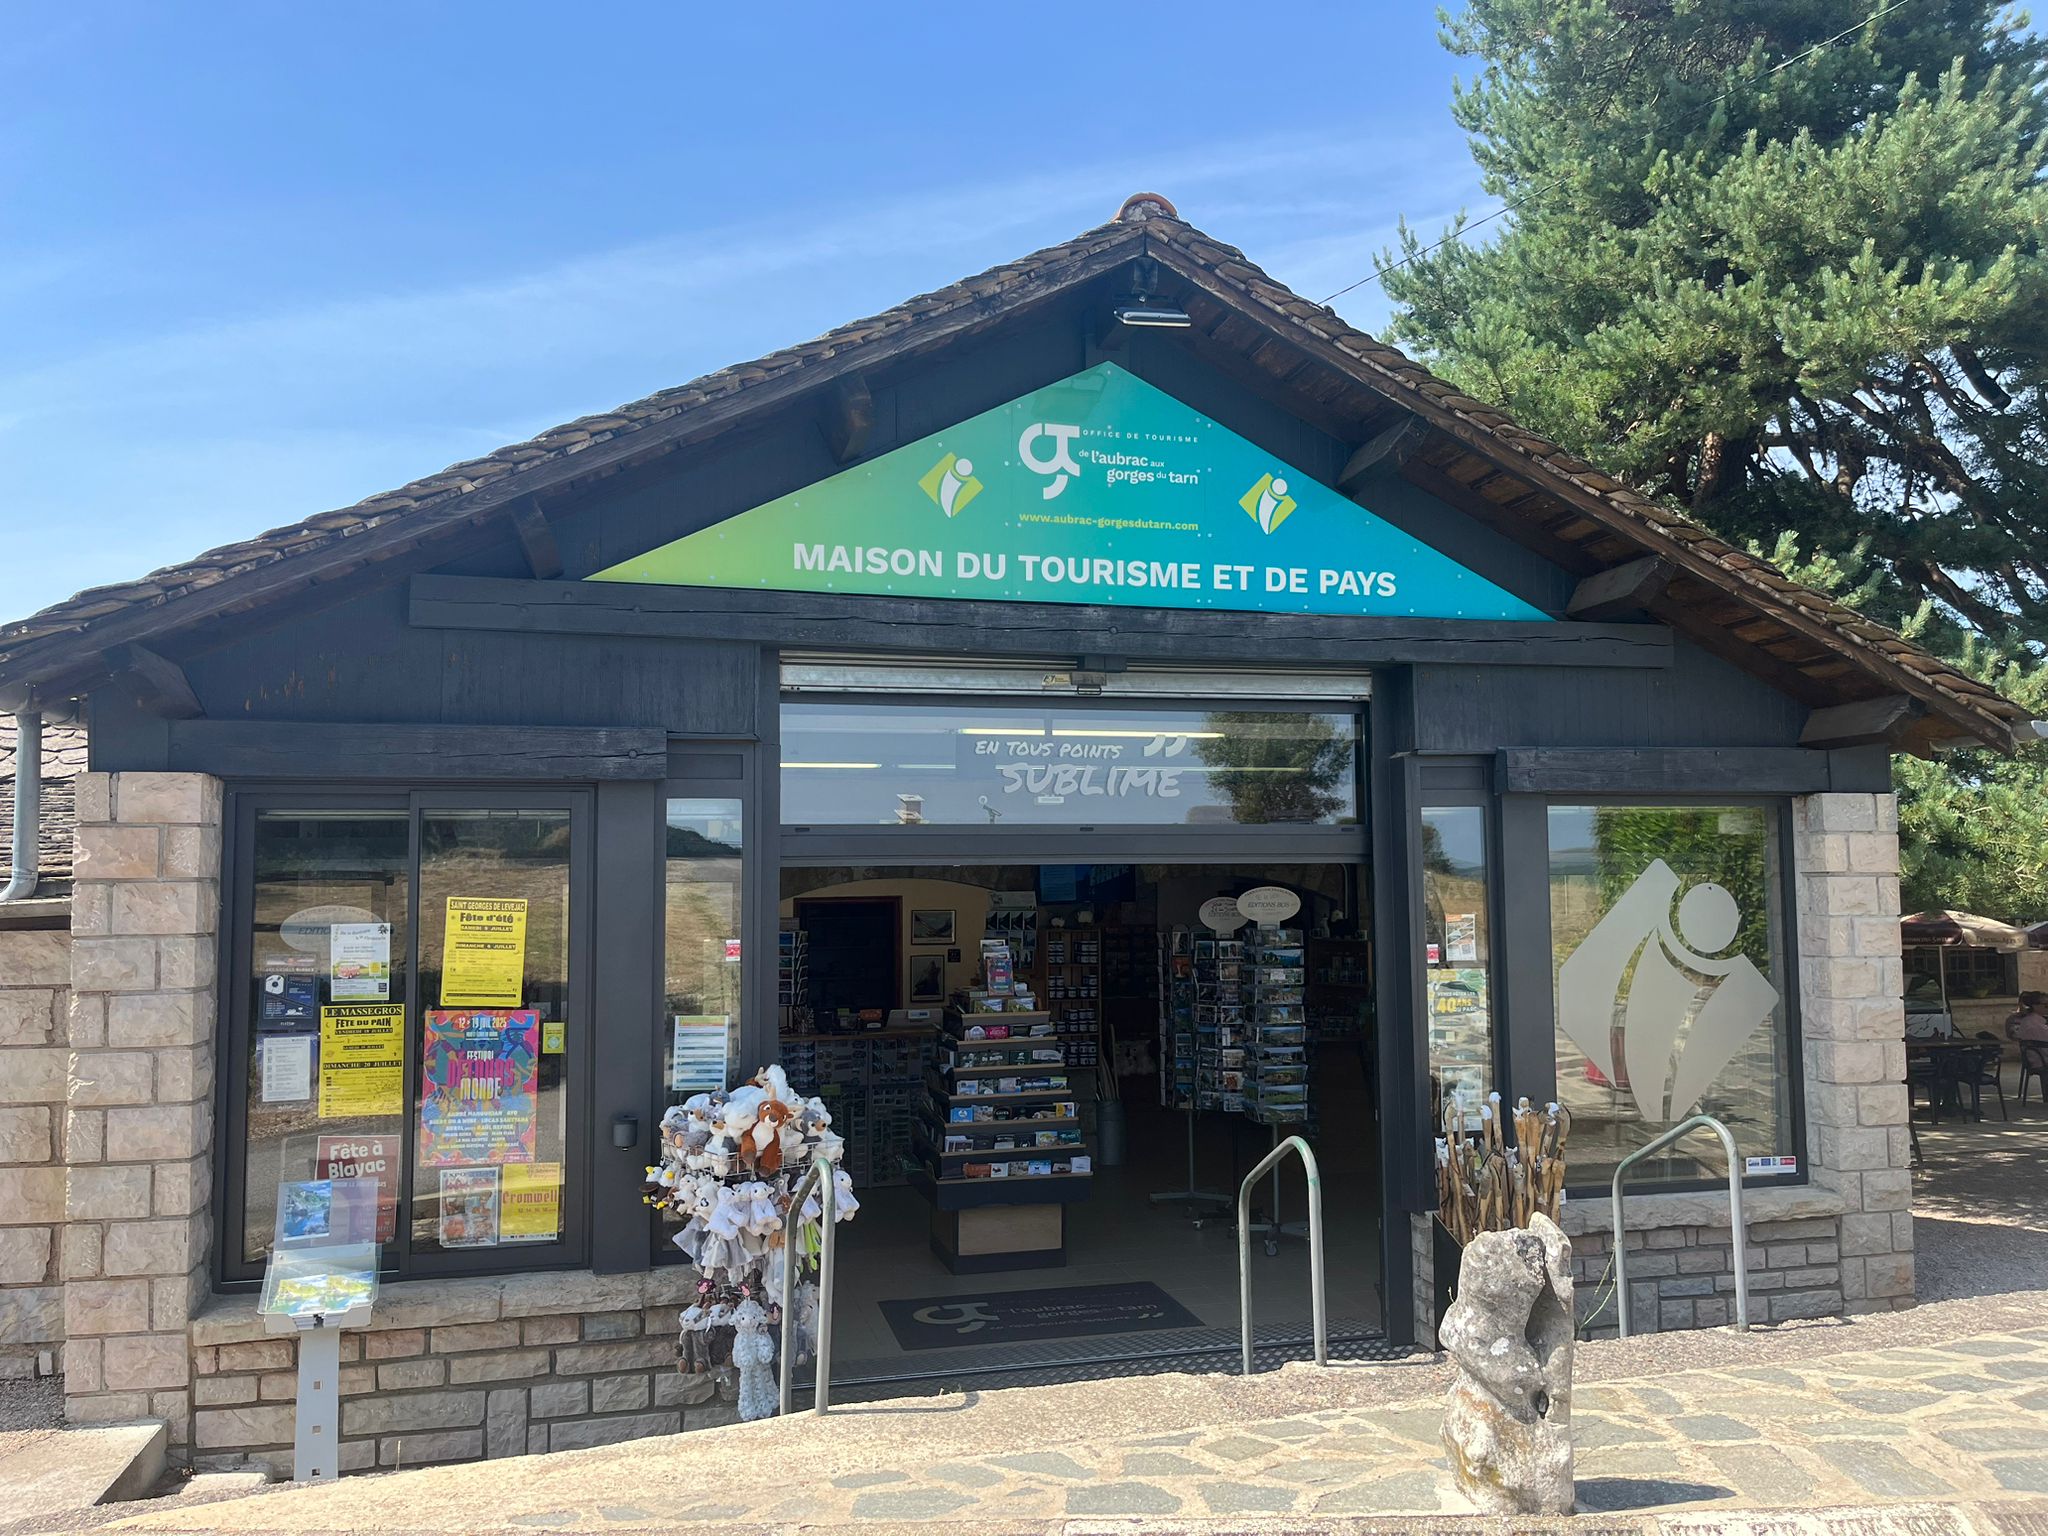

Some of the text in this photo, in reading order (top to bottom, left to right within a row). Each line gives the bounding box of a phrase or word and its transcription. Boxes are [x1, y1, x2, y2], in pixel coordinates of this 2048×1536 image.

[1082, 428, 1199, 443] OFFICE DE TOURISME
[1078, 449, 1089, 458] de
[1150, 460, 1165, 468] aux
[1106, 468, 1199, 484] gorges du tarn
[1019, 512, 1199, 531] www.aubrac-gorgesdutarn.com
[794, 543, 1396, 596] MAISON DU TOURISME ET DE PAYS
[974, 740, 1124, 759] EN TOUS POINTS
[1001, 762, 1184, 797] SUBLIME
[468, 901, 493, 910] GEORGES
[493, 902, 501, 910] DE
[325, 1006, 402, 1016] LE MASSEGROS
[1436, 997, 1456, 1014] 40
[371, 1017, 391, 1027] PAIN
[458, 1017, 466, 1028] 12
[472, 1017, 479, 1028] 19
[492, 1016, 507, 1028] 2025
[330, 1140, 383, 1161] Fête à
[328, 1160, 386, 1179] Blayac
[502, 1189, 558, 1205] Cromwell
